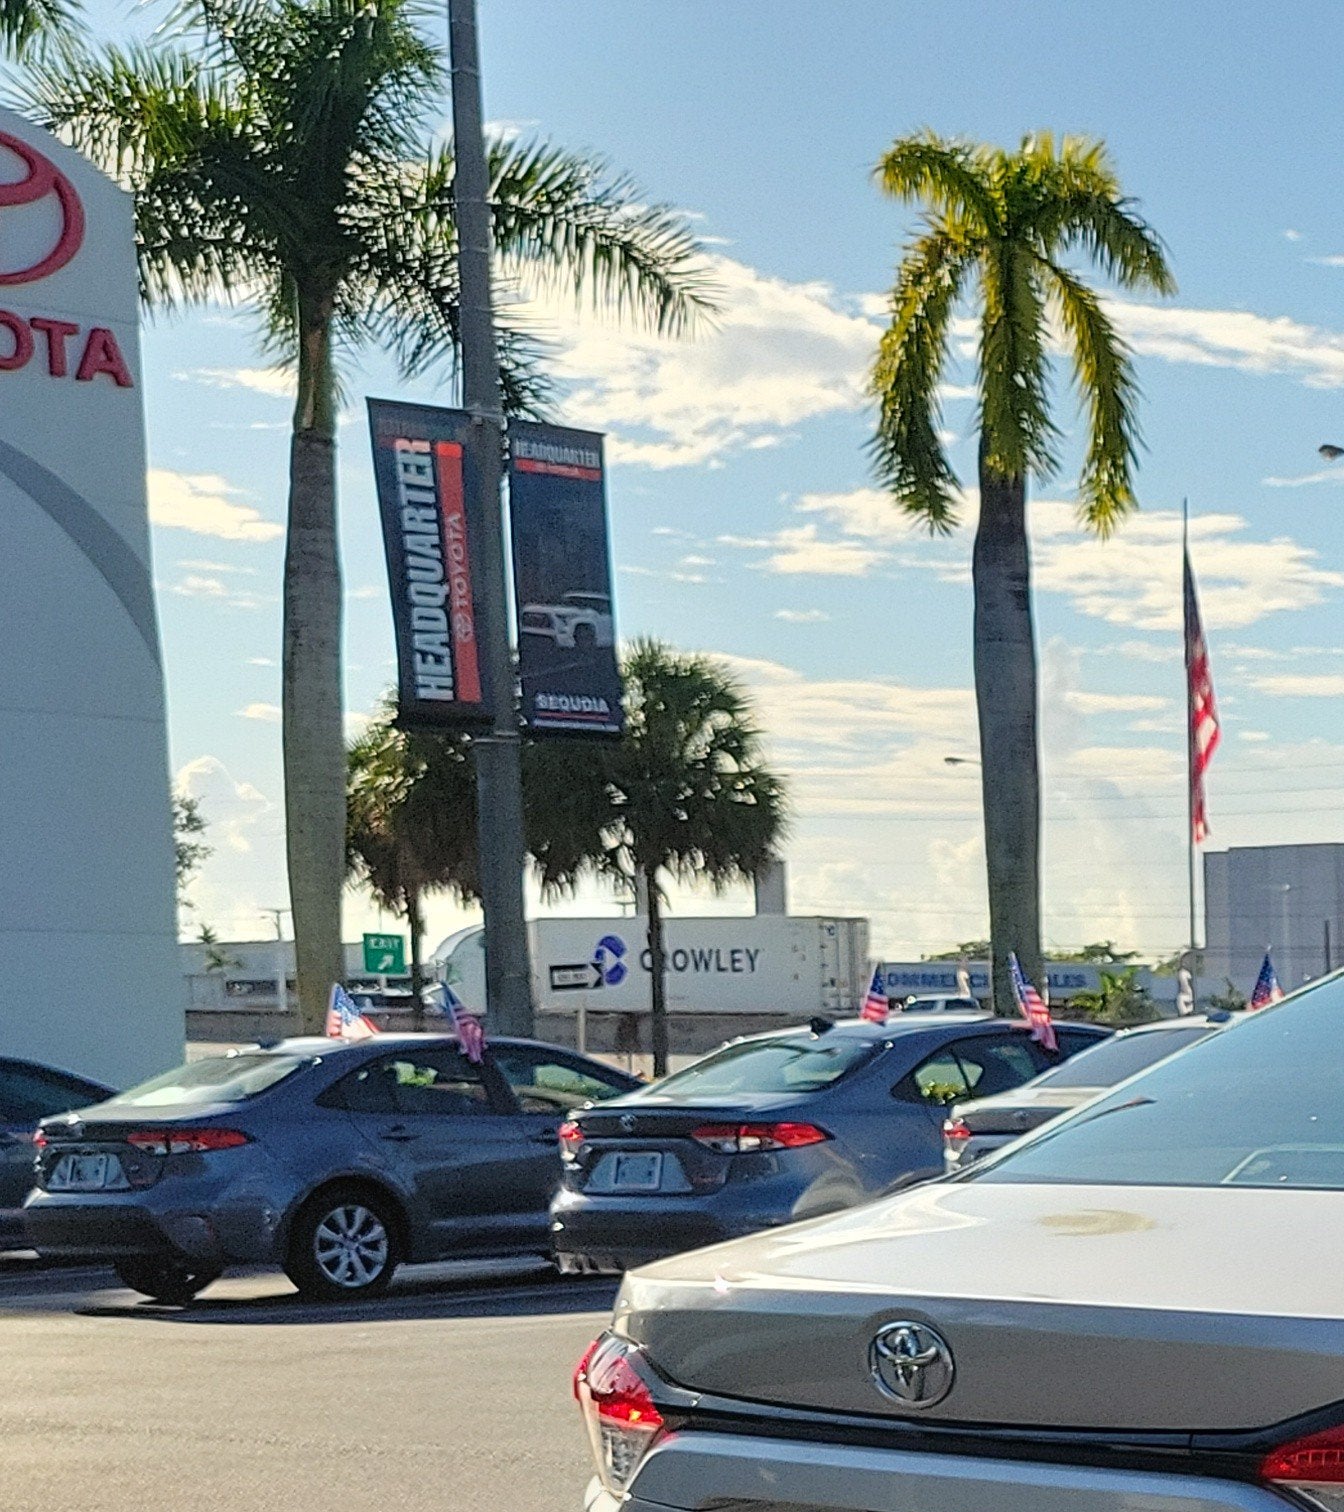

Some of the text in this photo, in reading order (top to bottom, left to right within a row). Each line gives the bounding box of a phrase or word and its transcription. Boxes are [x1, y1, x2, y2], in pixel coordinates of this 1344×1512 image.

[395, 437, 454, 700] HEADQUARTER
[446, 513, 472, 607] TOYOTA
[640, 948, 760, 973] COWLEY
